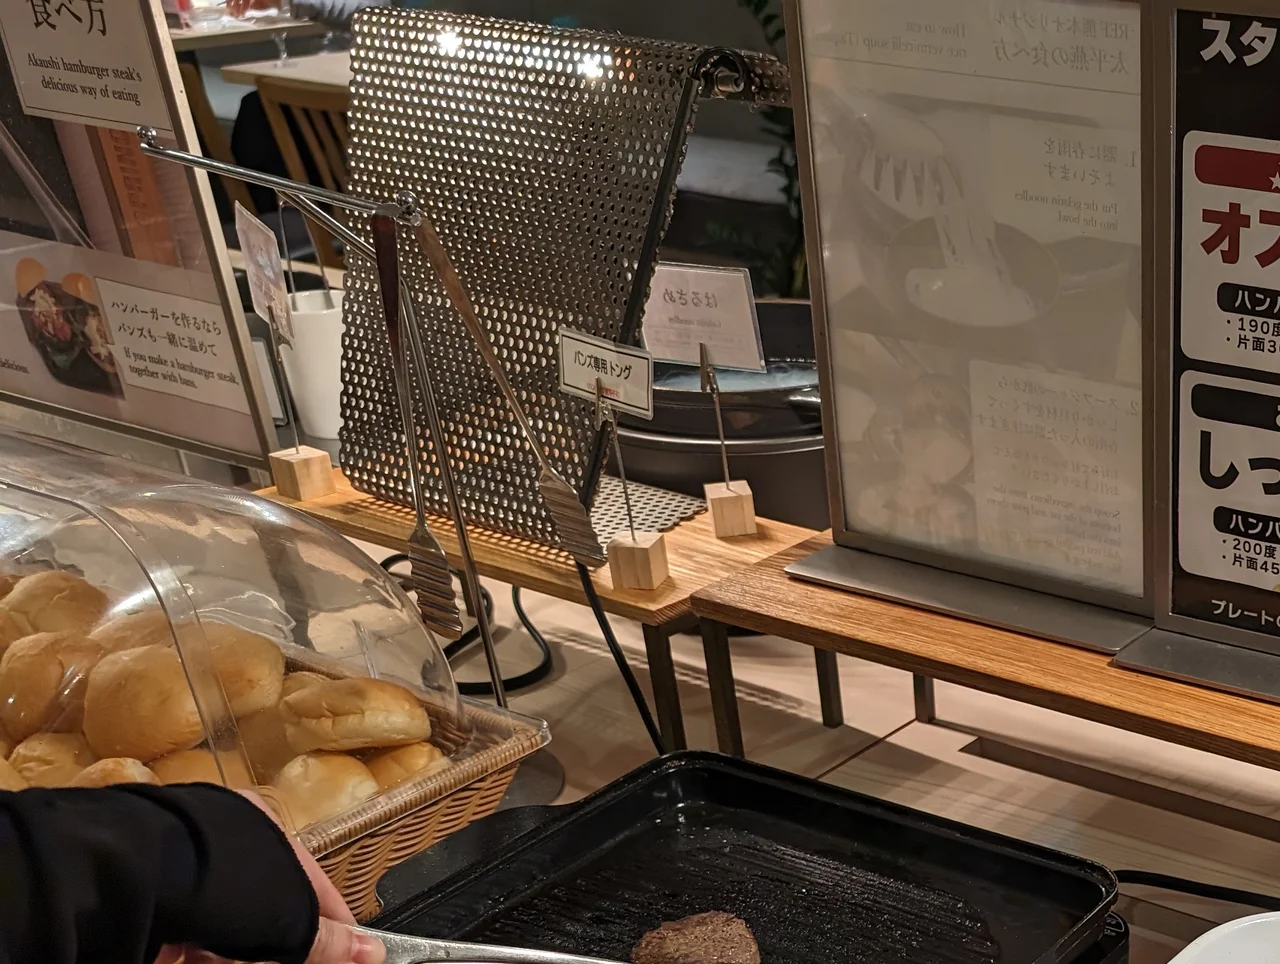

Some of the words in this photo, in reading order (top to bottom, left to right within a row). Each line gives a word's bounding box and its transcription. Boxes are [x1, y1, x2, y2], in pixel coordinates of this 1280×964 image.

[28, 53, 60, 70] Akaushi
[62, 57, 109, 79] hamburger
[112, 66, 142, 82] steak's
[41, 76, 78, 94] delicious
[80, 85, 97, 99] way
[100, 84, 109, 98] of
[112, 89, 140, 106] eating
